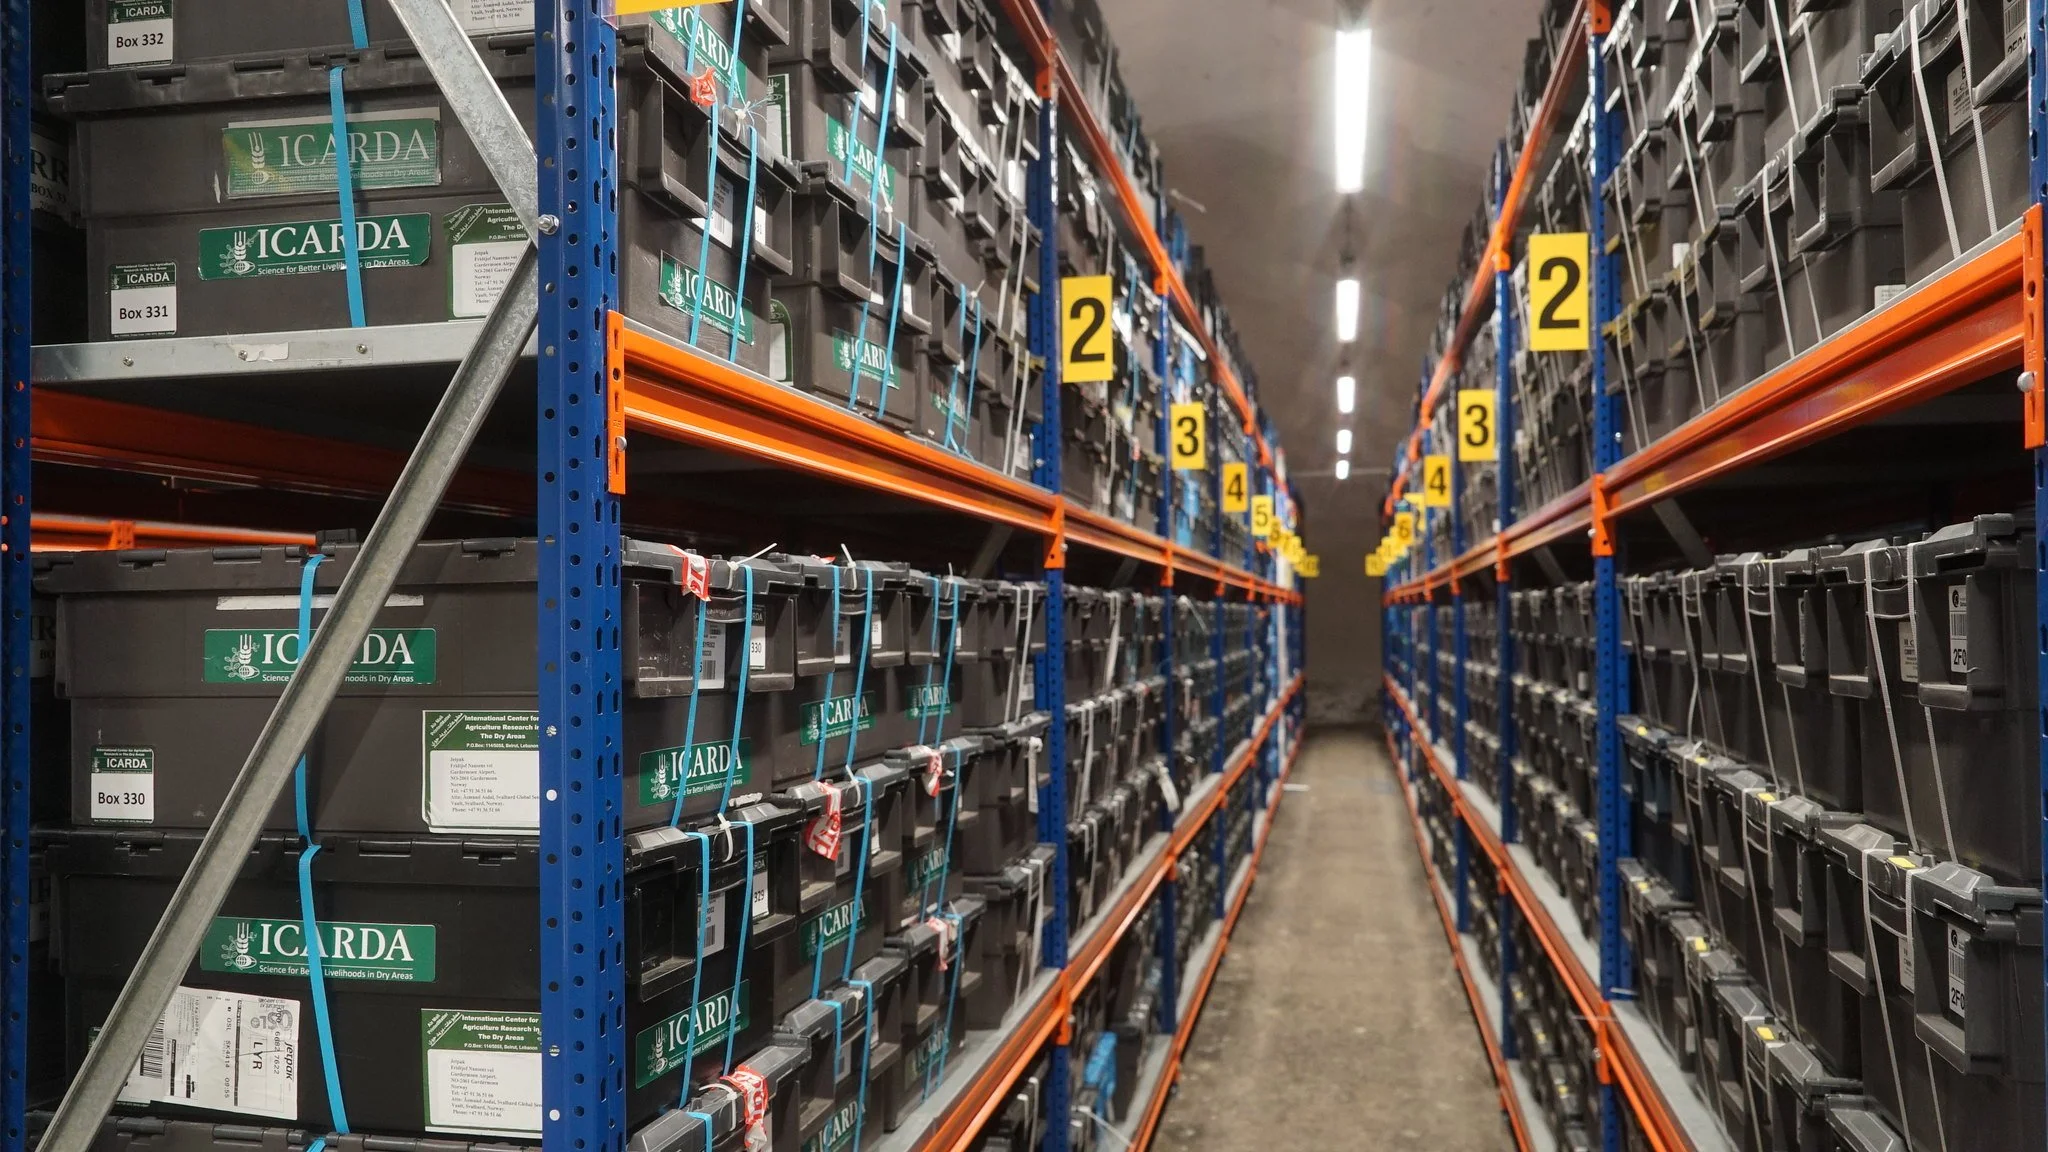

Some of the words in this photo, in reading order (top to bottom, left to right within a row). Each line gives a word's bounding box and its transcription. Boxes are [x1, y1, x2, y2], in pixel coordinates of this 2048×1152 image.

[126, 5, 165, 17] ICARDA
[116, 36, 138, 48] Box
[142, 33, 164, 46] 332
[127, 272, 170, 284] ICARDA
[298, 264, 320, 272] Better
[322, 261, 362, 271] Livelihs
[1538, 256, 1580, 329] 2
[120, 308, 142, 320] Box
[146, 305, 168, 318] 331
[1069, 297, 1106, 363] 2
[1176, 416, 1199, 457] 3
[1464, 404, 1489, 446] 3
[1227, 472, 1244, 502] 4
[1430, 466, 1447, 496] 4
[1256, 504, 1268, 527] 5
[262, 633, 414, 665] ICDA
[378, 674, 391, 684] Dry
[106, 758, 148, 769] ICARDA
[98, 792, 120, 805] Box
[123, 792, 145, 805] 330
[260, 923, 414, 962] ICARDA
[259, 966, 286, 974] Science
[324, 968, 366, 978] Livelihoods
[376, 971, 390, 980] Dry
[392, 971, 413, 980] Areas
[252, 1041, 263, 1070] LYR
